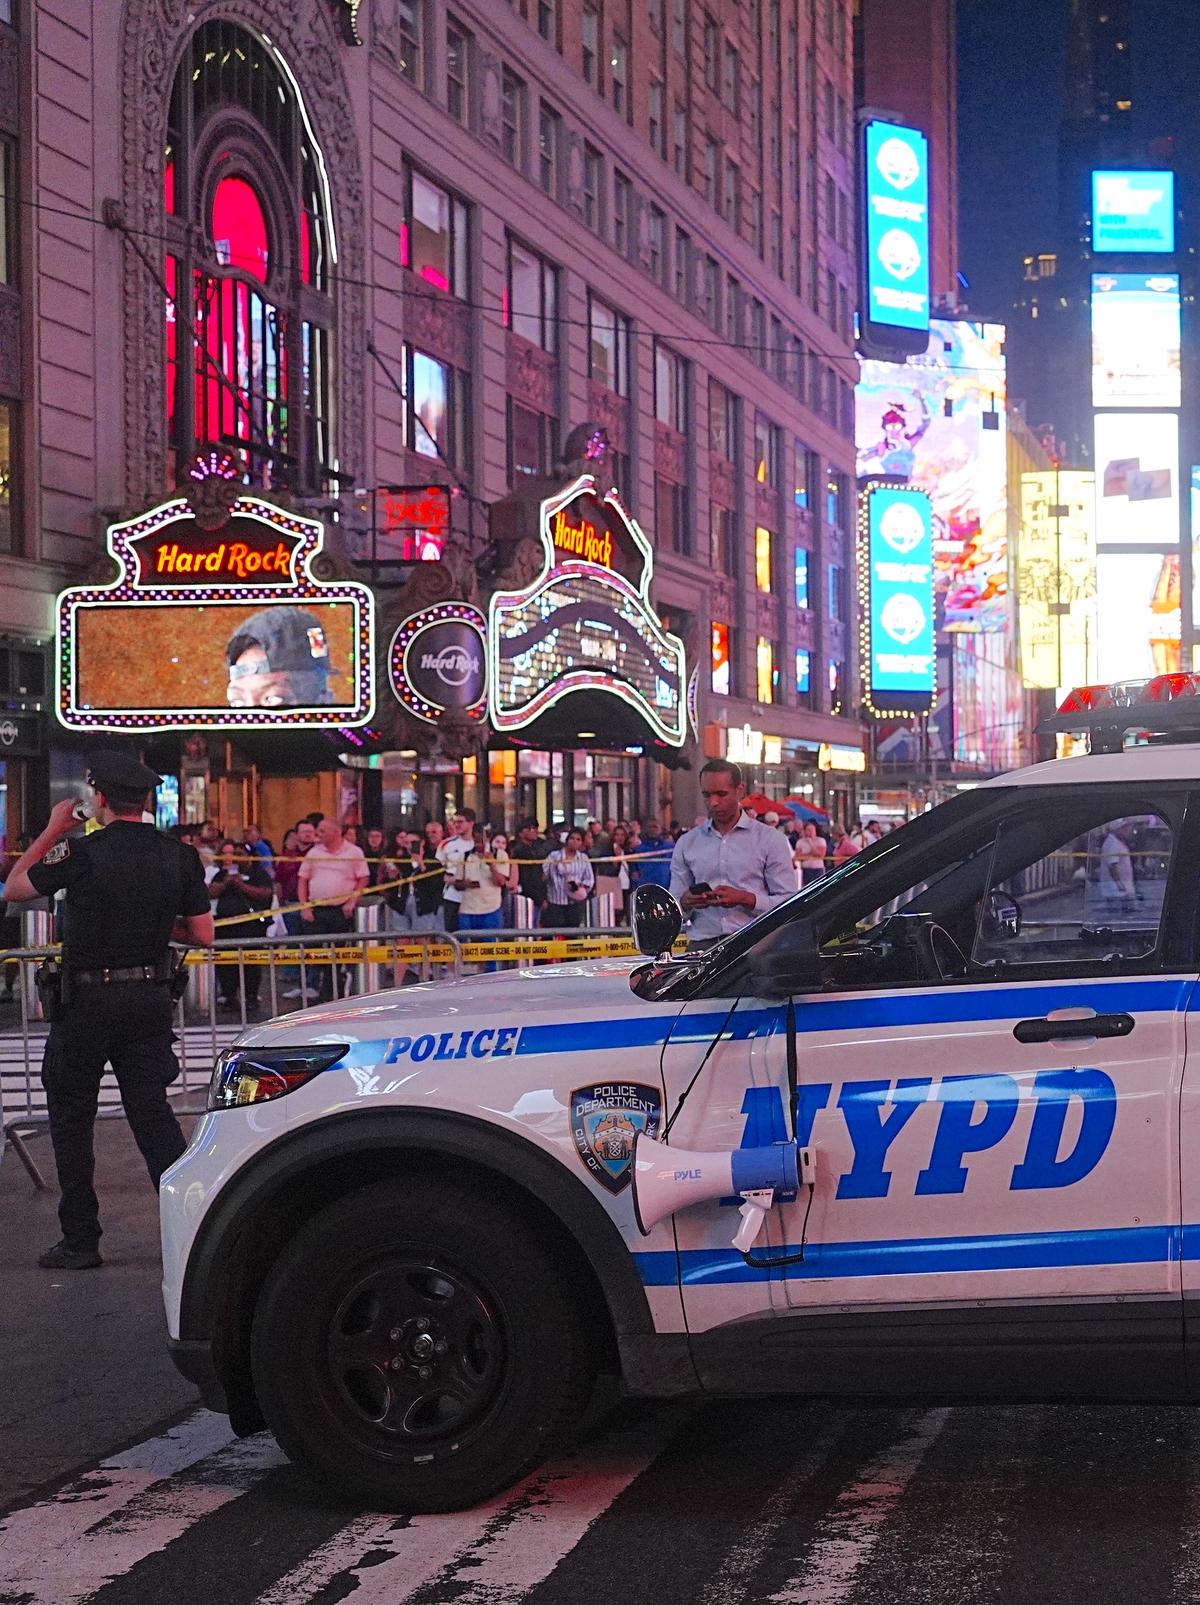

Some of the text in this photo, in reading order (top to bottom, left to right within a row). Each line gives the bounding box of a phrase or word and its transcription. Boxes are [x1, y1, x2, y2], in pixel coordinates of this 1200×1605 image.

[554, 512, 613, 570] Hard Rock
[157, 542, 291, 578] Hard Rock
[420, 654, 480, 674] Hard Rock
[495, 945, 511, 956] SCENE
[522, 945, 532, 955] NOT
[385, 1026, 519, 1065] POLICE
[593, 1085, 637, 1099] POLICE
[575, 1096, 656, 1117] DEPARTMENT
[574, 1128, 589, 1159] CITY
[586, 1157, 601, 1172] OF
[719, 1066, 1118, 1207] NYPD
[673, 1169, 702, 1181] PYLE
